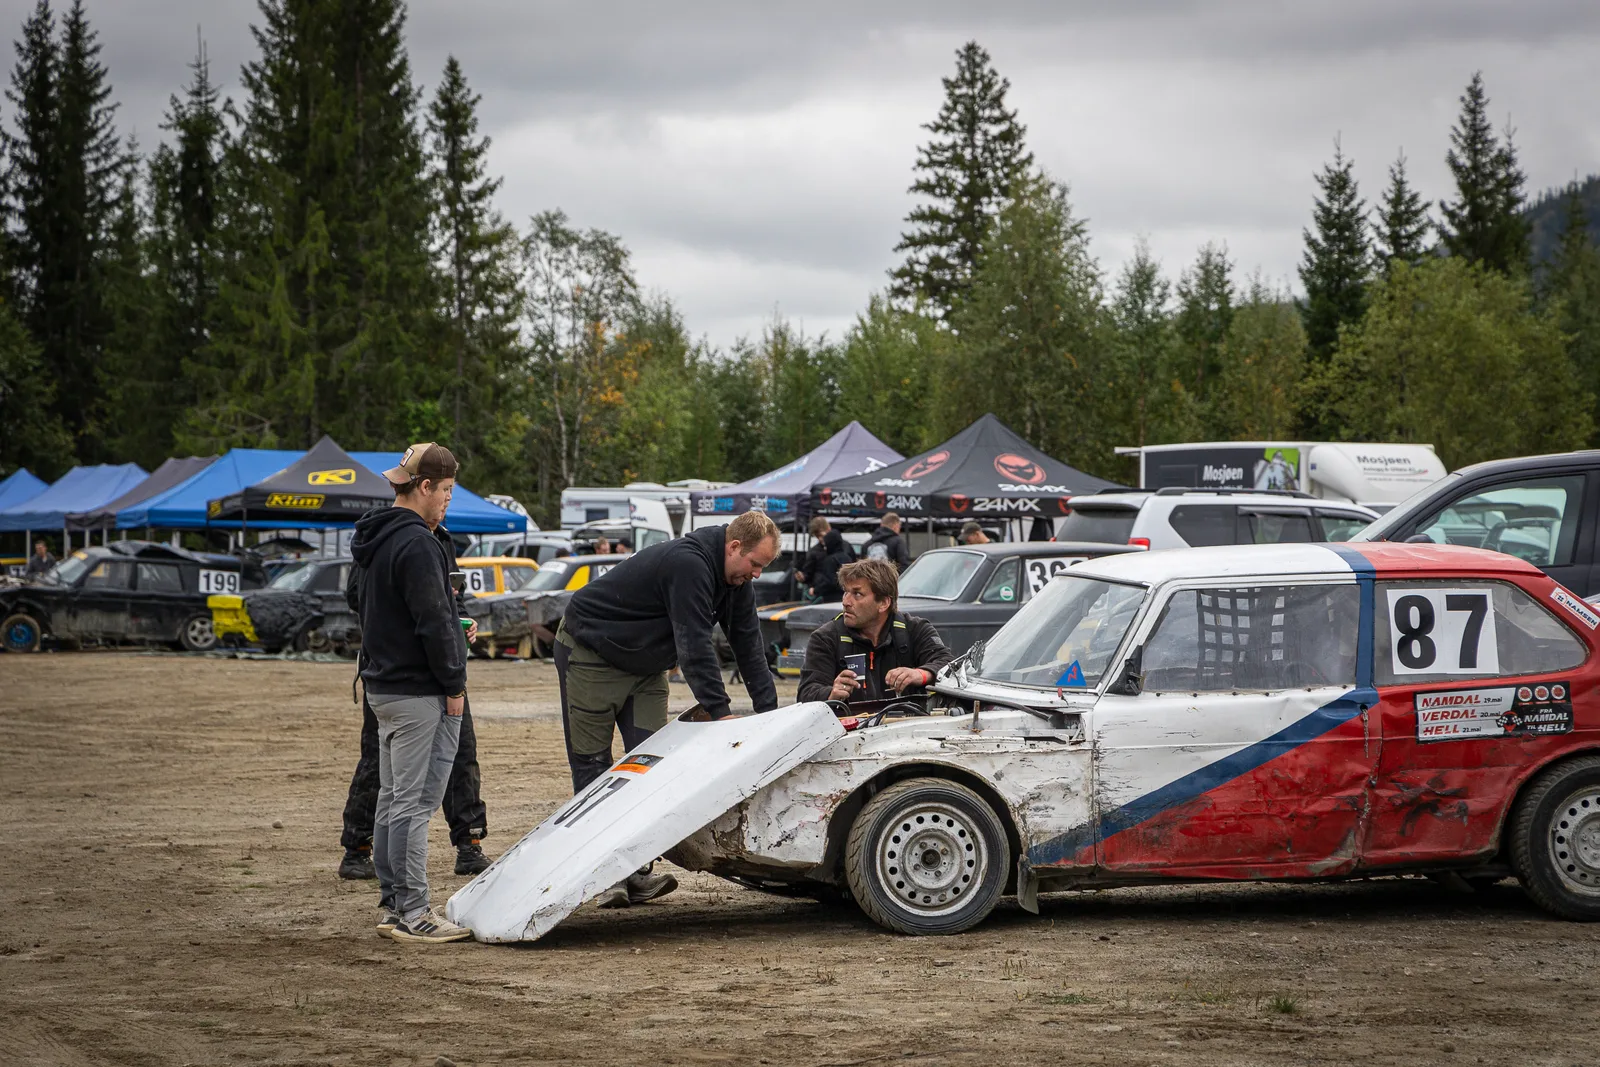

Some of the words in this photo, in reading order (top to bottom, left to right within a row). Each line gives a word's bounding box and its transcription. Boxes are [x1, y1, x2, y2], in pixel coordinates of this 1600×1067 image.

[831, 491, 867, 506] 24MX
[886, 495, 923, 510] 24MX
[972, 497, 1041, 512] 24MX
[202, 572, 239, 592] 199
[1566, 600, 1598, 626] NAMSEN
[1394, 594, 1488, 669] 87
[1421, 694, 1481, 708] NAMDAL
[1422, 709, 1478, 722] VERDAL
[1524, 713, 1569, 722] NAMDAL
[1423, 724, 1460, 736] HELL
[1537, 723, 1567, 732] HELL
